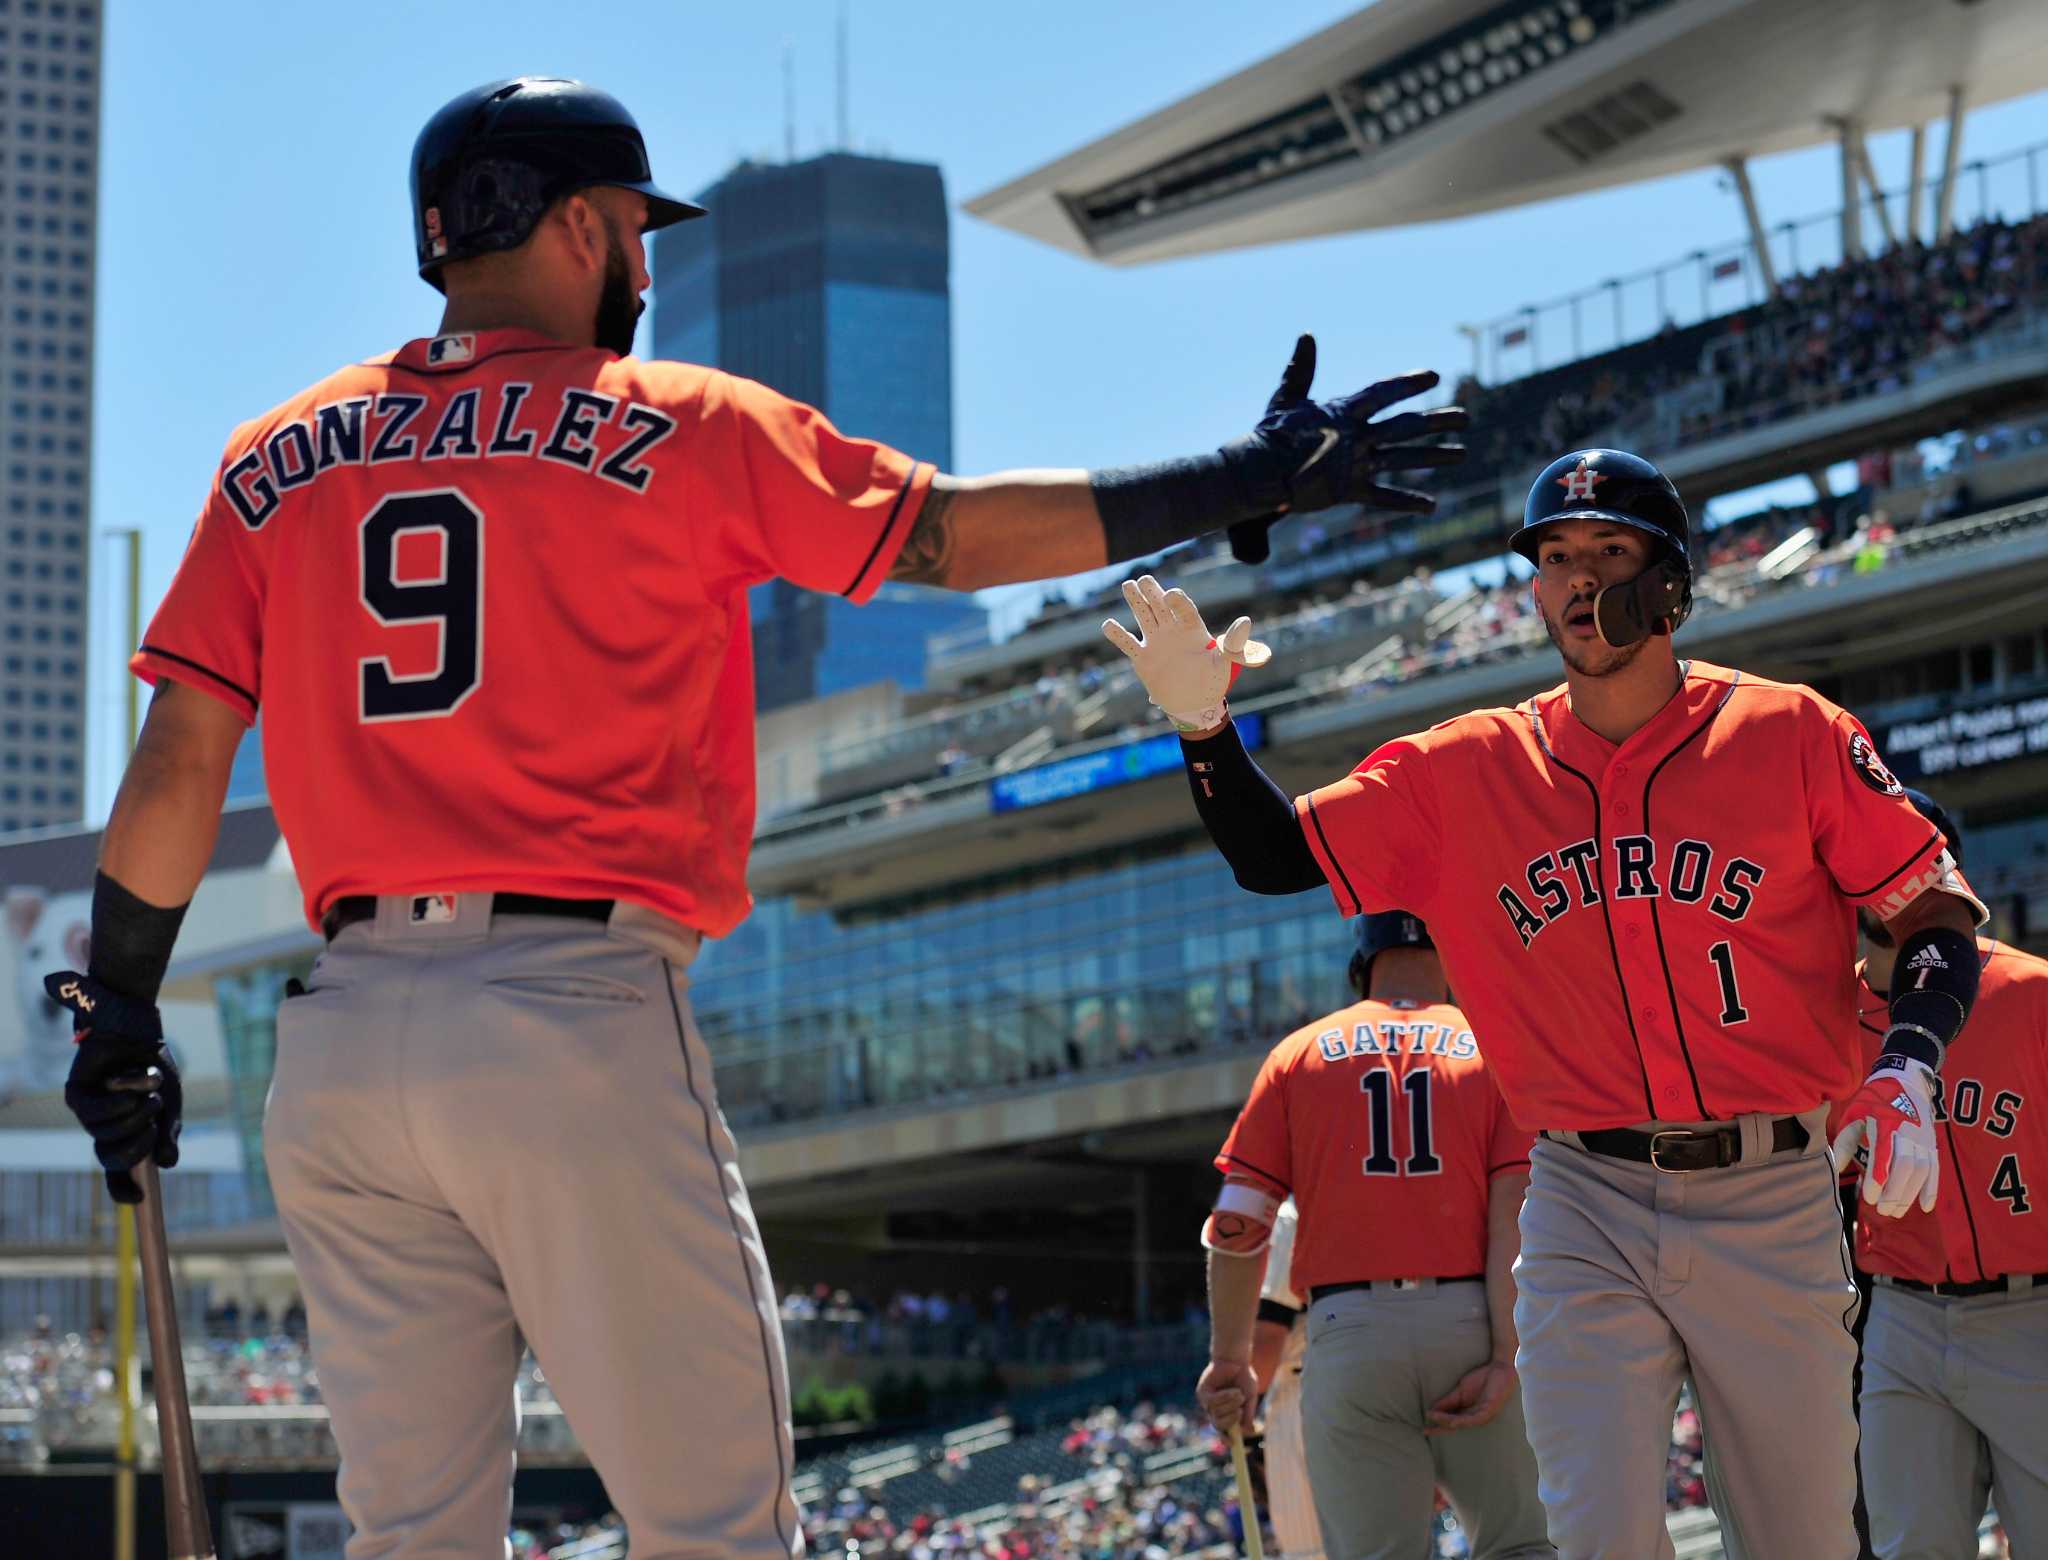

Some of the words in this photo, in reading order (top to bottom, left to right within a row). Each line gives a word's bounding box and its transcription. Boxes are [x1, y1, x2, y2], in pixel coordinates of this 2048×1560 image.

[221, 382, 678, 531] GONZALEZ
[1564, 469, 1598, 501] H
[358, 487, 484, 724] 9
[1496, 834, 1766, 950] ASTROS
[1707, 940, 1749, 1027] 1
[1907, 957, 1949, 969] adidas
[1913, 967, 1931, 989] 1
[1317, 1021, 1478, 1062] GATTIS
[1360, 1067, 1443, 1177] 11
[1932, 1074, 2024, 1139] ROS
[1987, 1153, 2032, 1216] 4
